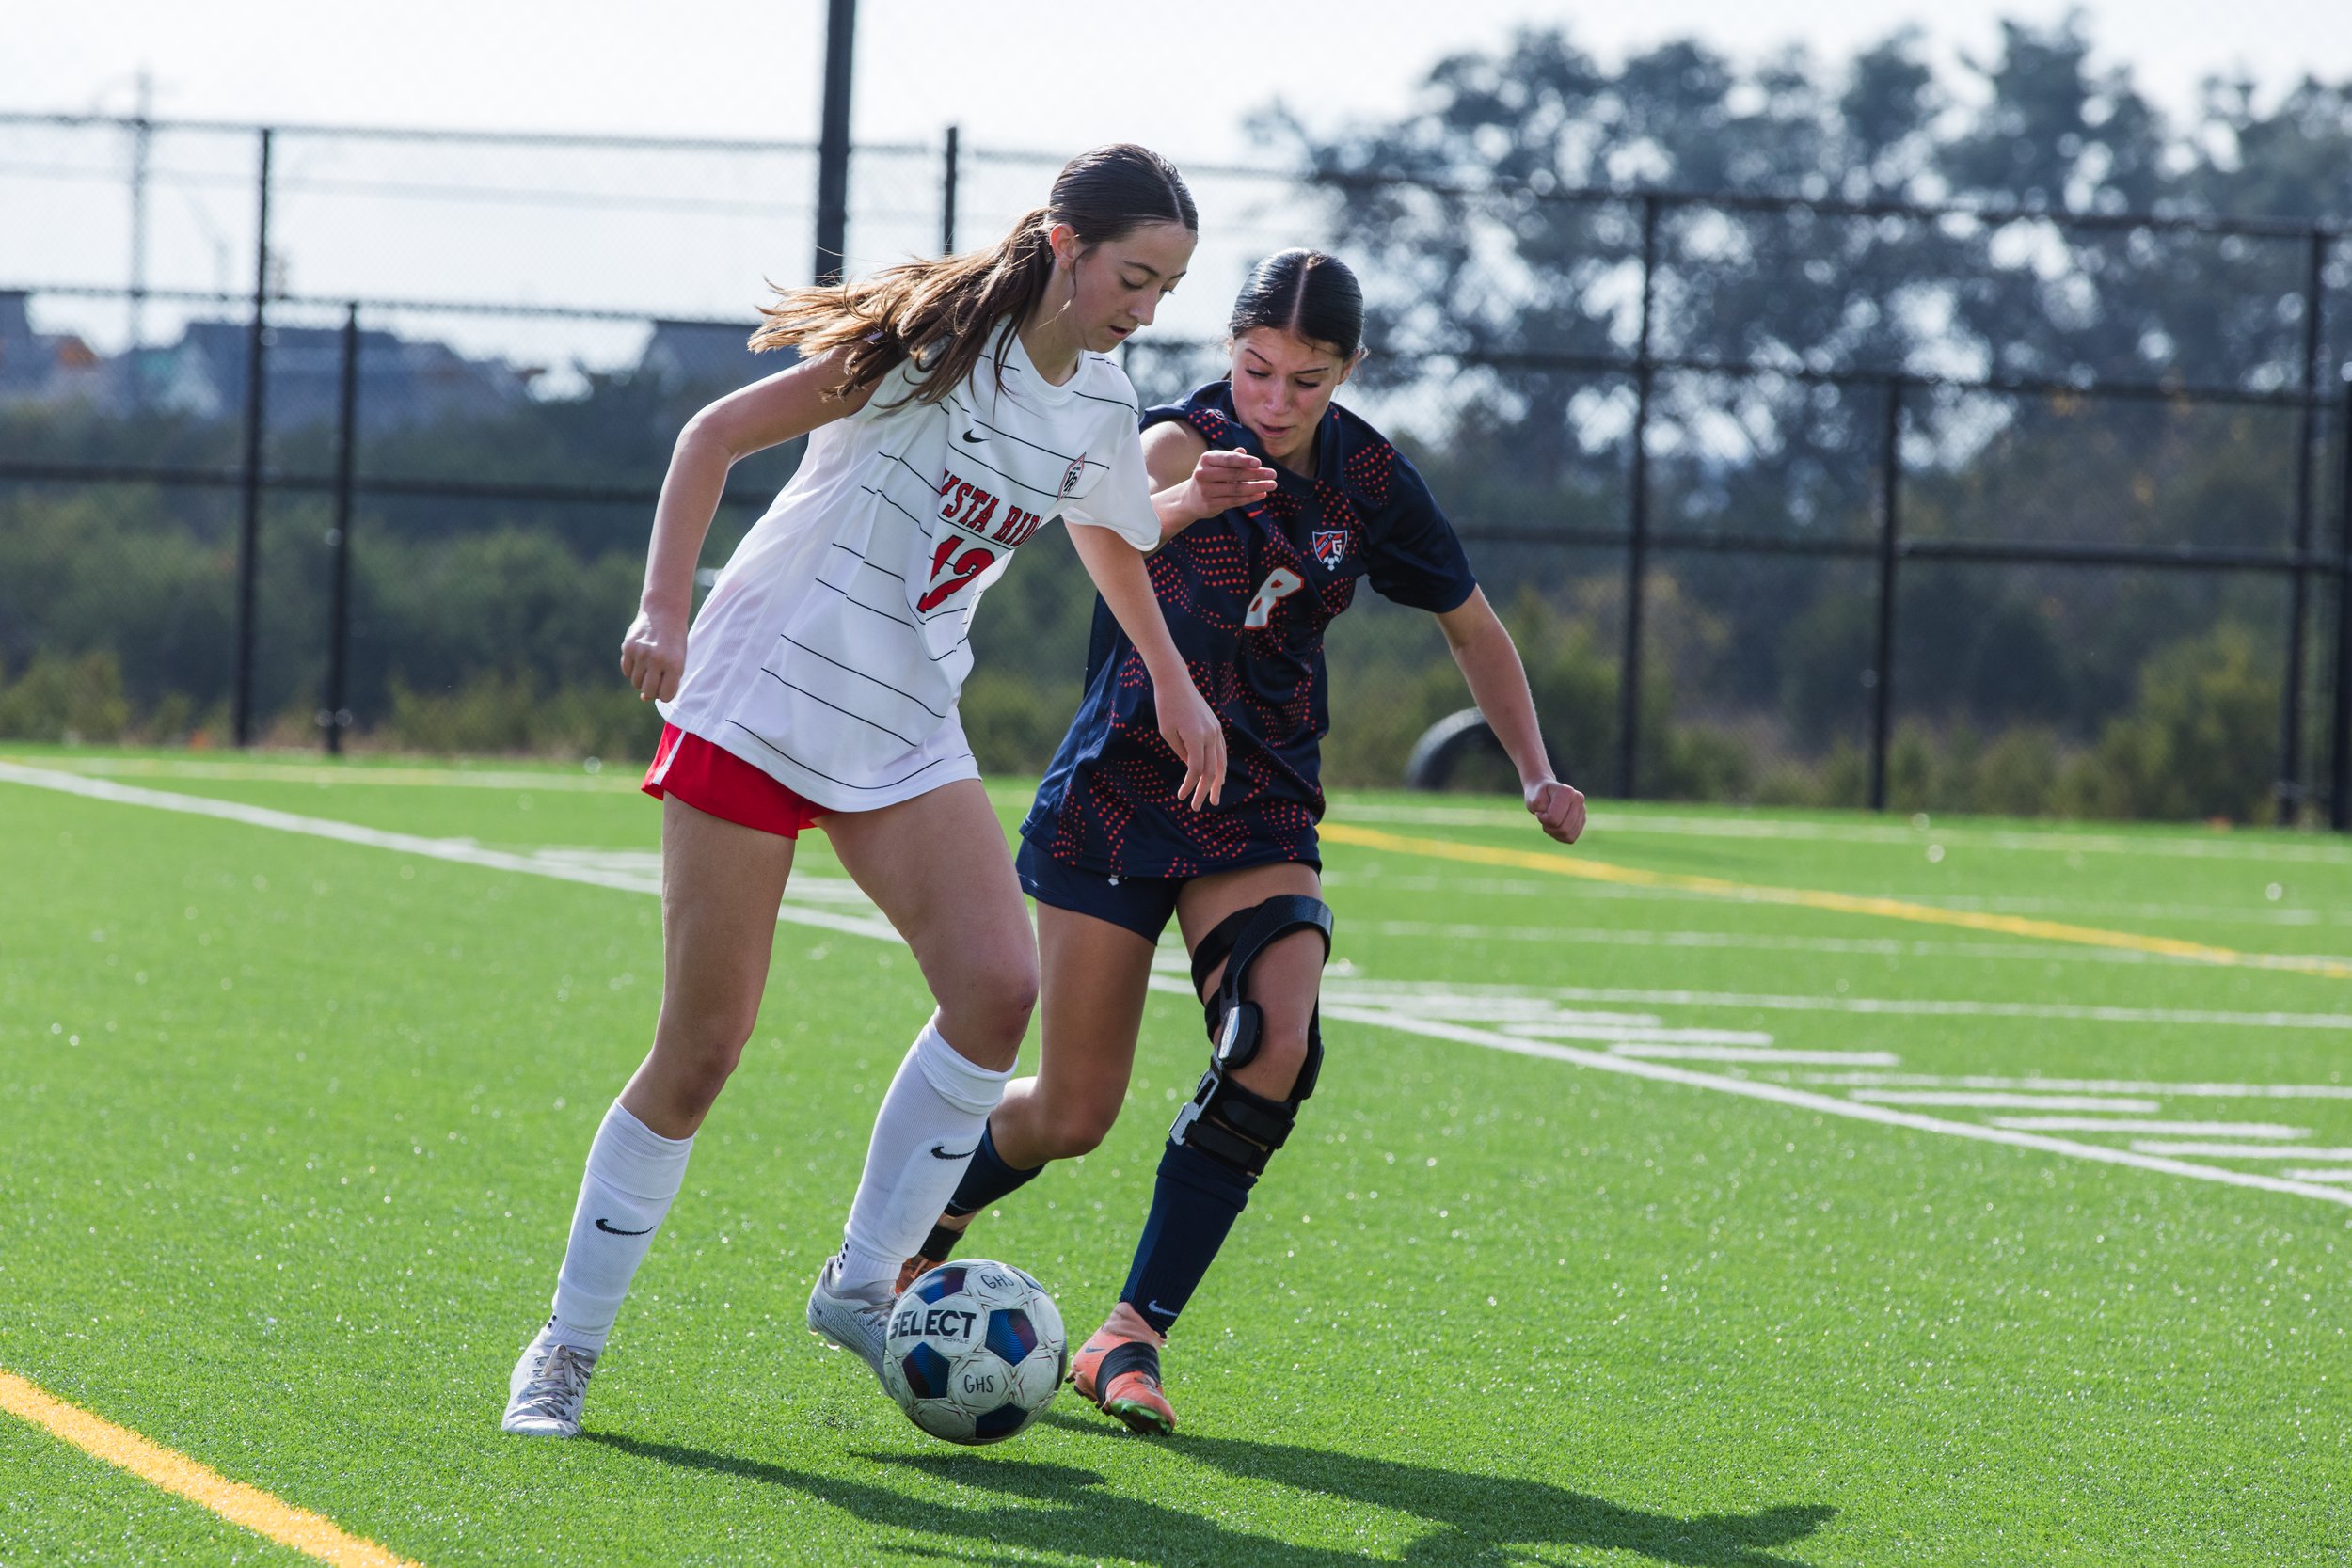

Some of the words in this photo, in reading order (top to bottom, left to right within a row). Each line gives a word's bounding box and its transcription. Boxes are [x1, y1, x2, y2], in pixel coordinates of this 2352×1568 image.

[941, 467, 1000, 533] ISTA
[991, 505, 1041, 547] RID
[1331, 539, 1343, 556] G
[980, 1274, 1015, 1290] GHS
[889, 1309, 977, 1341] SELECT
[942, 1336, 970, 1345] ROYALE
[963, 1374, 994, 1394] GHS
